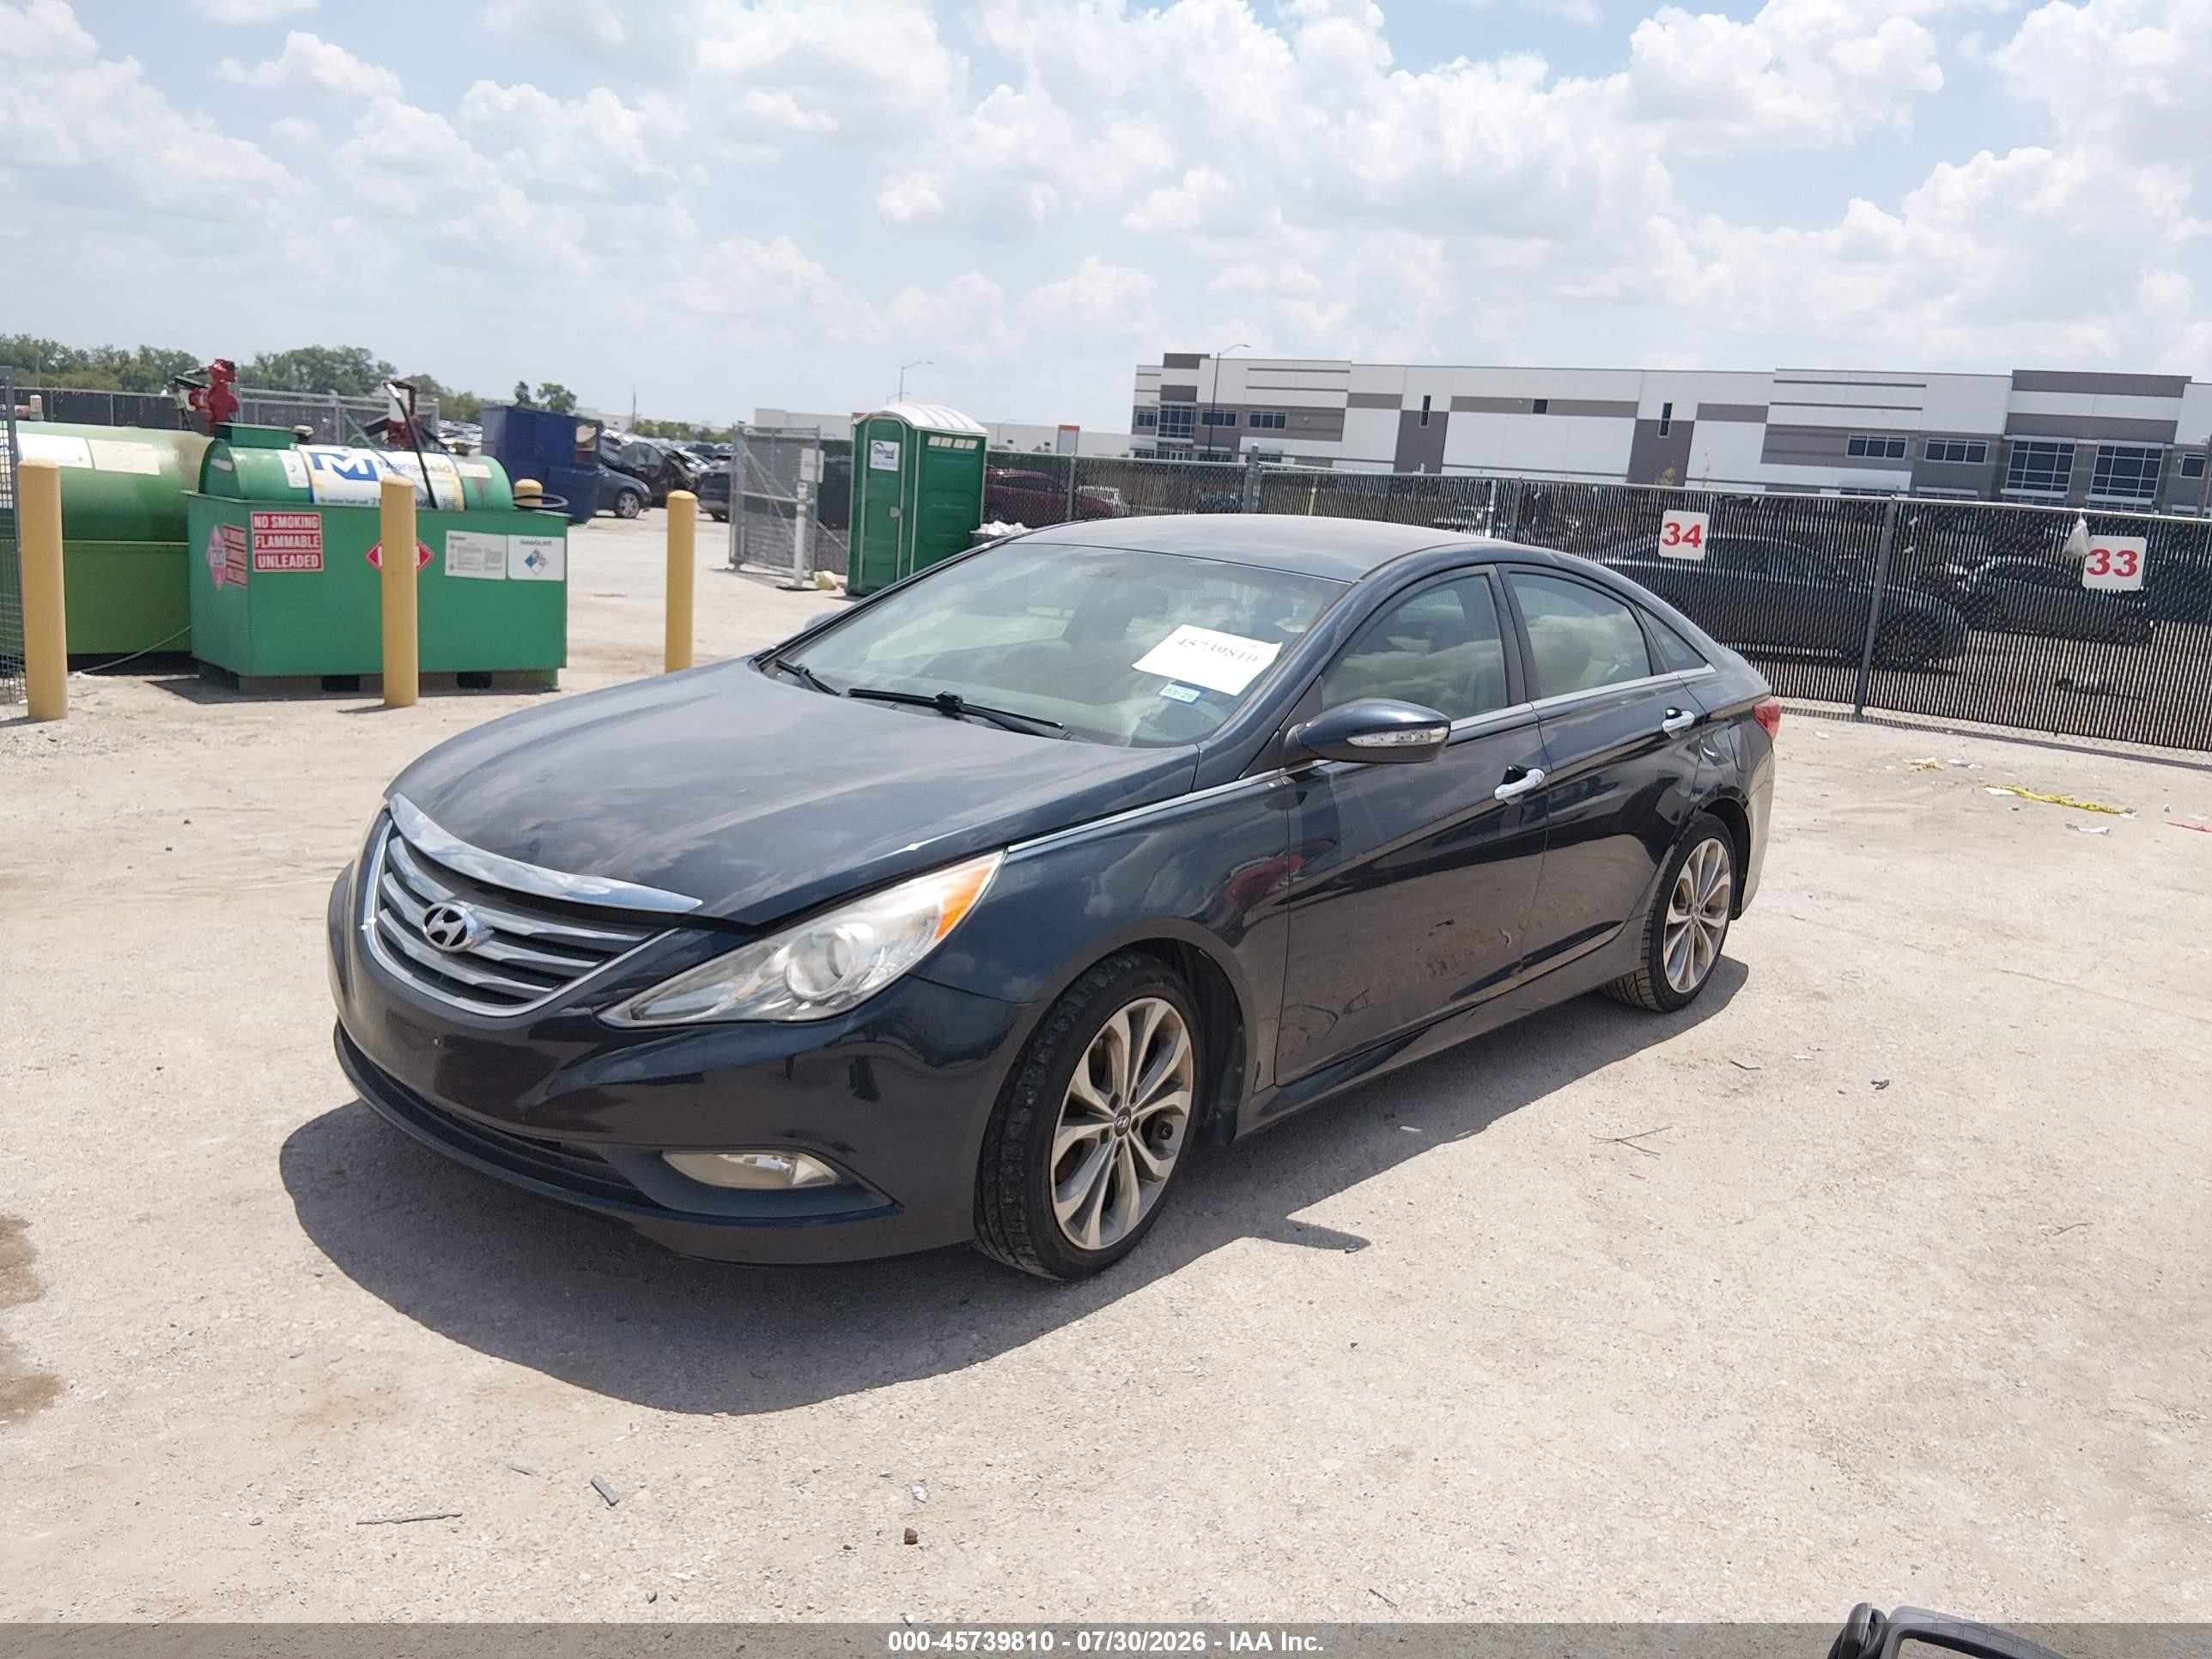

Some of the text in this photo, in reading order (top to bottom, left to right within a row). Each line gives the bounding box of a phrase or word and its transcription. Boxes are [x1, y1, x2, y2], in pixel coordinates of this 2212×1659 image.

[254, 515, 319, 529] NO SMOKING
[255, 535, 320, 549] FLAMMABLE
[1662, 522, 1701, 548] 34
[258, 555, 319, 568] UNLEADED
[2086, 549, 2137, 577] 33
